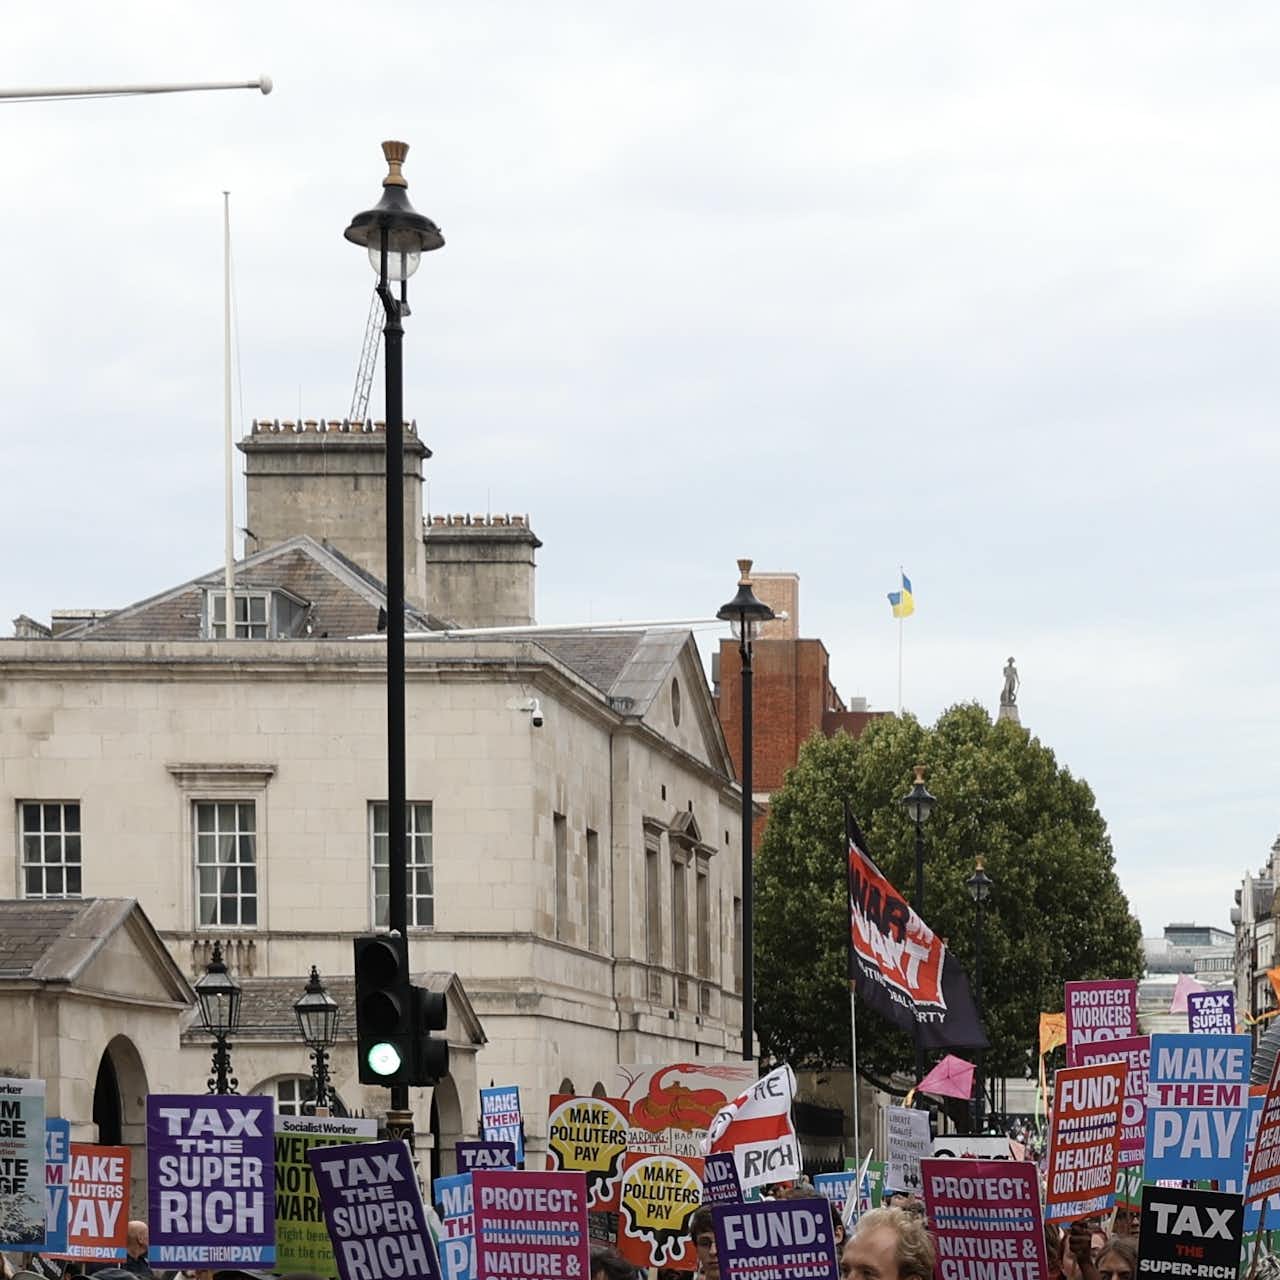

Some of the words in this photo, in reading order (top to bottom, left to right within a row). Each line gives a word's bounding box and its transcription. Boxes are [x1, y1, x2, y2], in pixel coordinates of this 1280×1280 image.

[1071, 989, 1131, 1006] PROTECT
[1191, 995, 1230, 1009] TAX
[1071, 1006, 1131, 1028] WORKERS
[1192, 1013, 1231, 1029] SUPER
[1072, 1027, 1132, 1046] NOT
[1157, 1047, 1243, 1080] MAKE
[483, 1092, 517, 1114] MAKE
[1060, 1074, 1121, 1113] FUND:
[1157, 1085, 1241, 1106] THEM
[159, 1107, 263, 1137] TAX
[485, 1111, 519, 1127] THEM
[569, 1108, 609, 1126] MAKE
[486, 1125, 520, 1142] PAY
[550, 1126, 627, 1147] POLLUTERS
[1152, 1111, 1242, 1159] PAY
[176, 1139, 243, 1154] THE
[574, 1146, 600, 1162] PAY
[1055, 1146, 1104, 1171] HEALTH
[1104, 1142, 1114, 1164] &
[69, 1155, 124, 1183] AKE
[461, 1149, 511, 1167] TAX
[743, 1143, 794, 1180] RICH
[1254, 1151, 1271, 1173] OUR
[159, 1155, 264, 1188] SUPER
[275, 1166, 313, 1194] NOT
[320, 1154, 405, 1188] TAX
[643, 1166, 682, 1185] MAKE
[1053, 1171, 1075, 1195] OUR
[1076, 1164, 1112, 1192] FUTURES
[69, 1184, 123, 1199] LLUTERS
[341, 1185, 395, 1204] THE
[623, 1183, 700, 1205] POLLUTERS
[930, 1176, 1031, 1200] PROTECT:
[441, 1183, 474, 1217] MA
[481, 1187, 579, 1213] PROTECT:
[160, 1190, 265, 1234] RICH
[333, 1200, 419, 1238] SUPER
[646, 1203, 673, 1221] PAY
[934, 1205, 1035, 1232] BILLIONAIRES
[1150, 1202, 1236, 1241] TAX
[278, 1227, 303, 1242] Fight
[482, 1218, 581, 1247] BILLIONAIRES
[723, 1210, 828, 1251] FUND:
[278, 1246, 295, 1258] Tax
[298, 1246, 315, 1259] the
[938, 1236, 1018, 1259] NATURE
[1022, 1239, 1038, 1259] &
[1175, 1244, 1204, 1259] THE
[483, 1250, 563, 1275] NATURE
[565, 1254, 582, 1277] &
[782, 1251, 830, 1280] FUELS
[1139, 1258, 1237, 1280] SUPER-RICH
